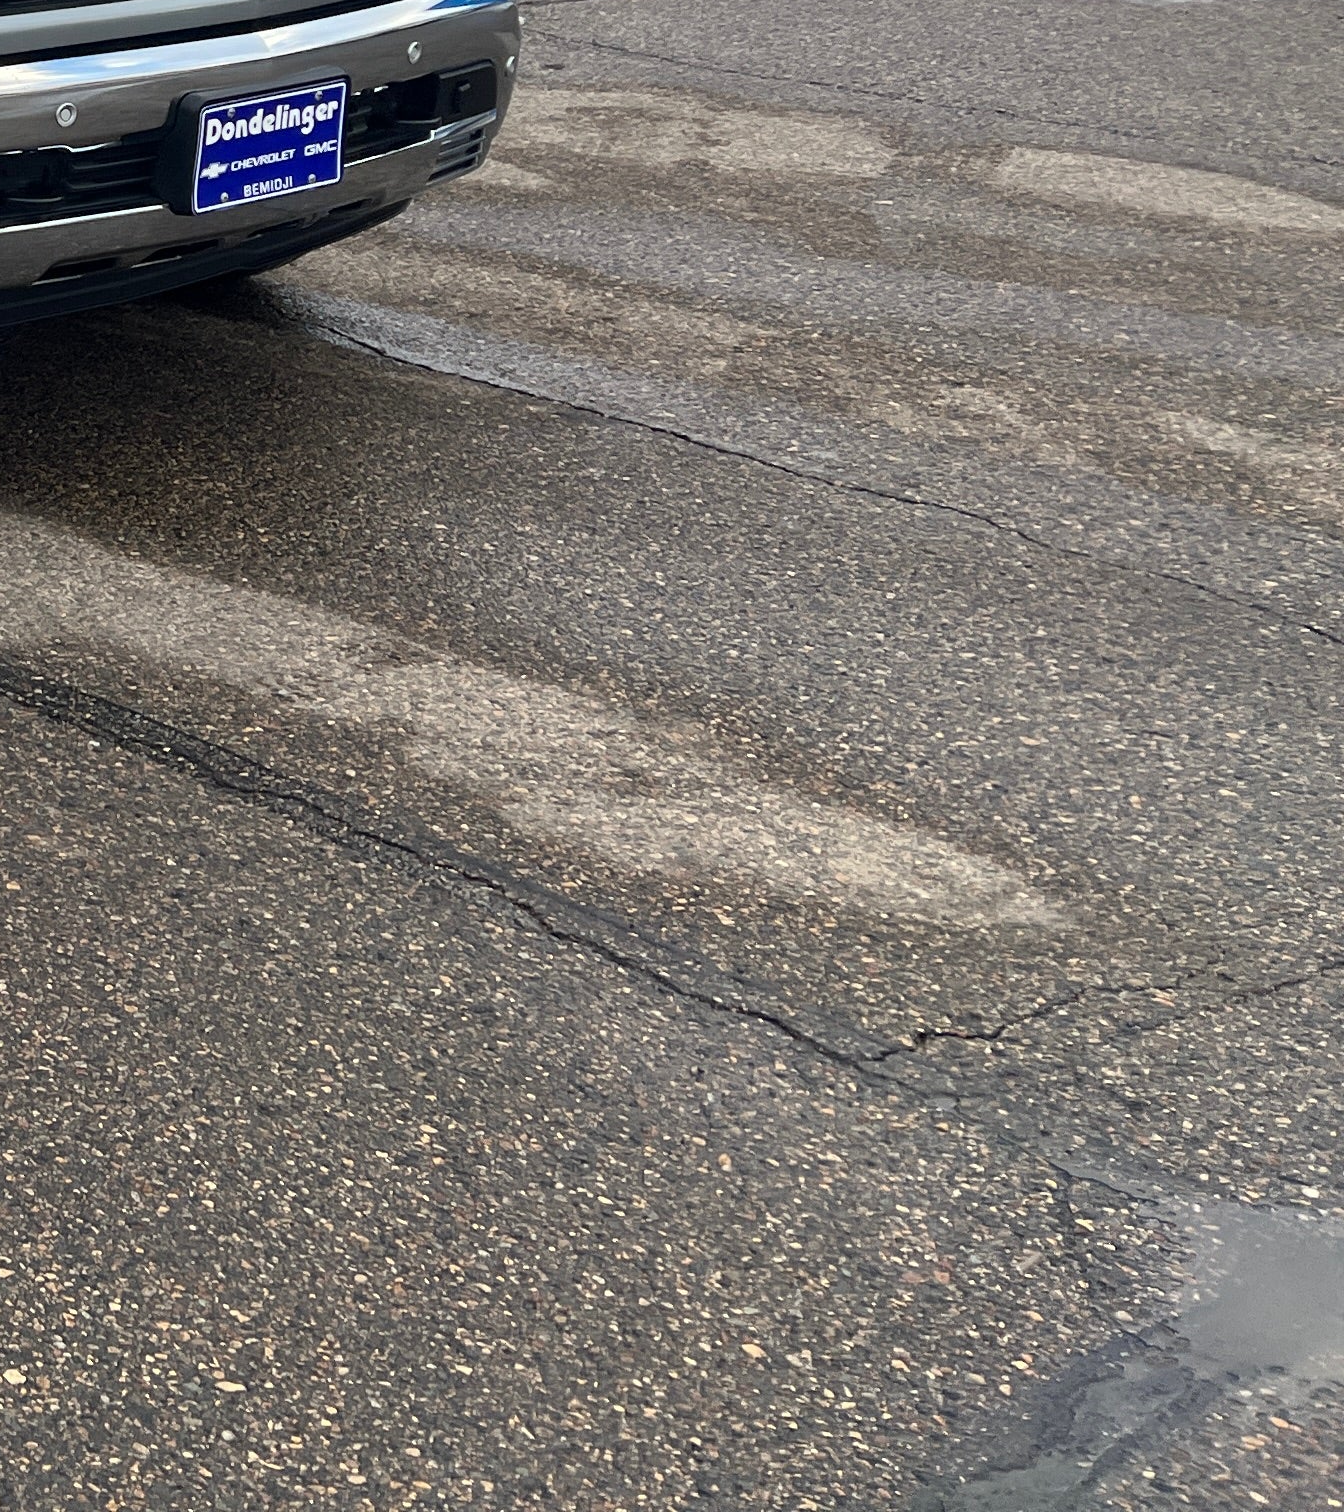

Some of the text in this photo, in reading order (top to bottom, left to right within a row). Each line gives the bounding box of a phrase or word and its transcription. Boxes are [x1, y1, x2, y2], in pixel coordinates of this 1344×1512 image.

[205, 101, 339, 146] Dondelinger
[230, 139, 338, 172] CHEVROLET GMC
[243, 176, 293, 198] BEMIDJI
